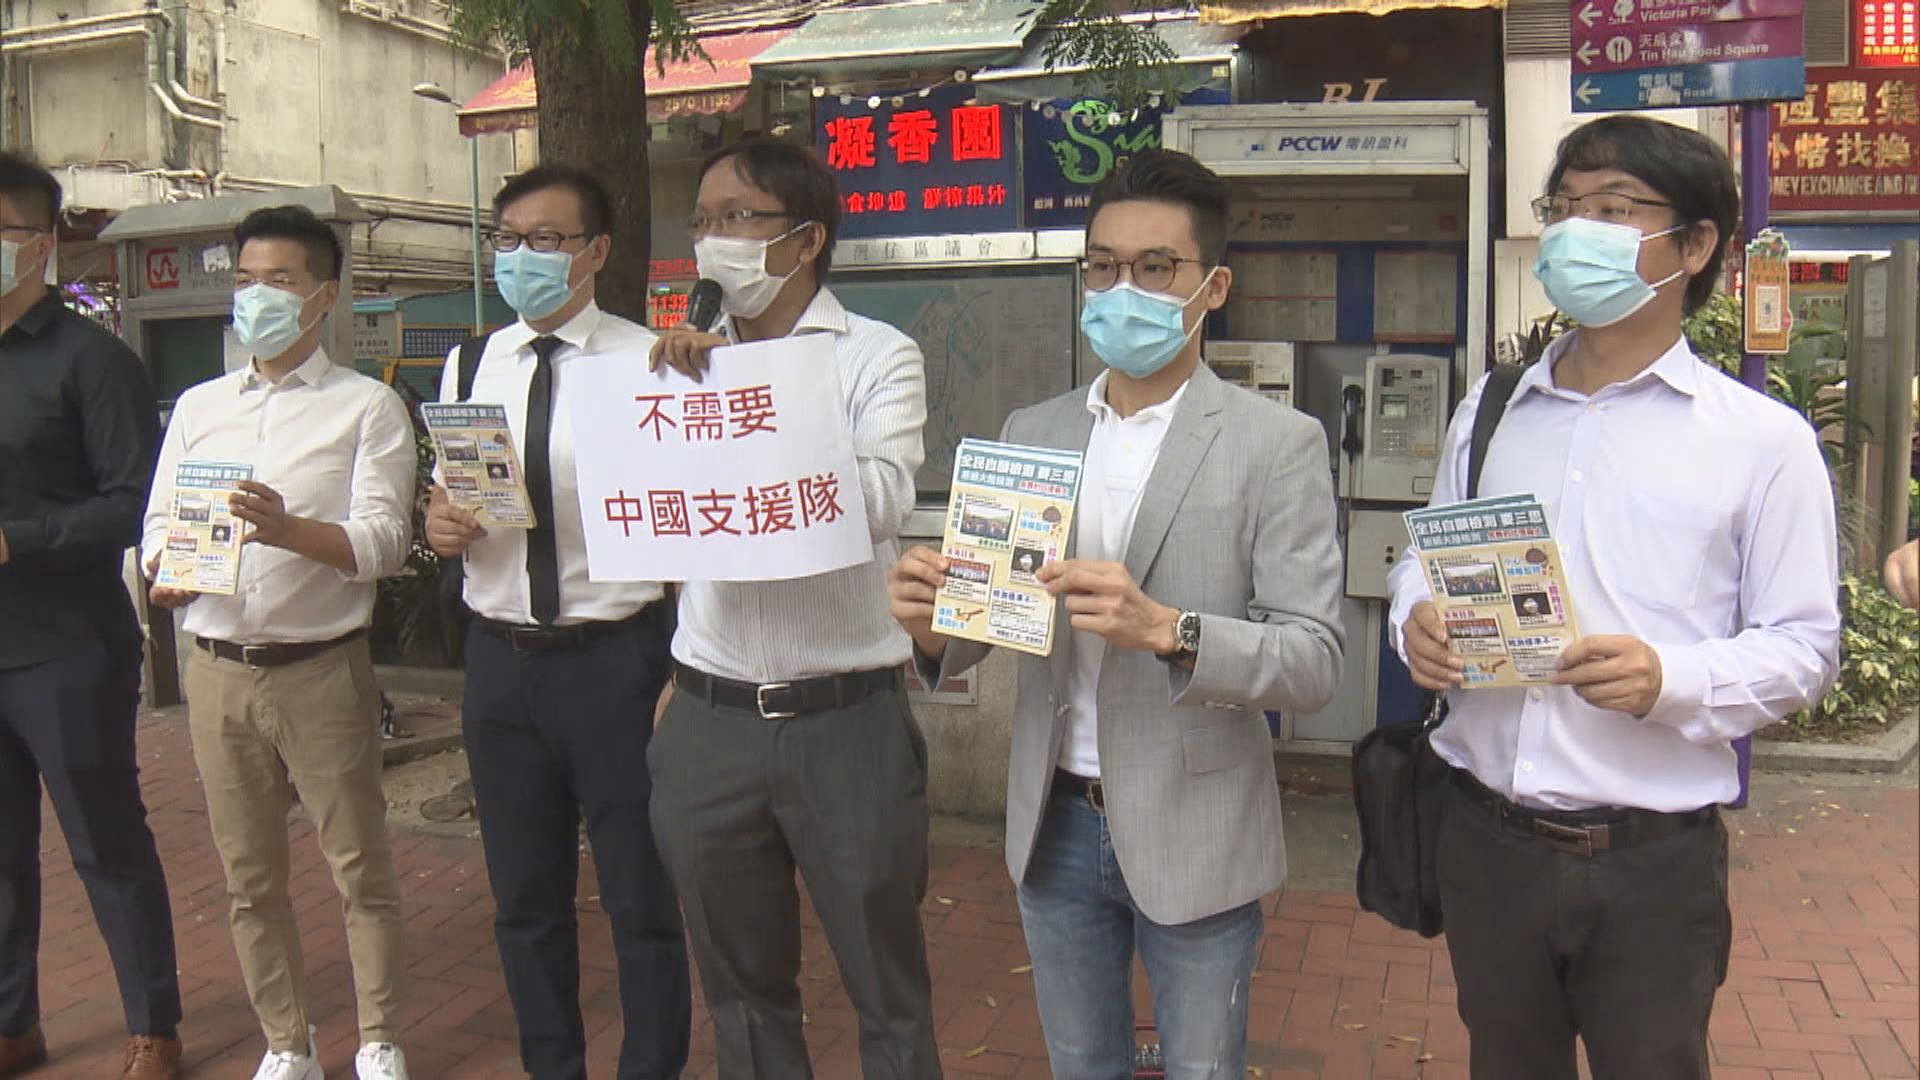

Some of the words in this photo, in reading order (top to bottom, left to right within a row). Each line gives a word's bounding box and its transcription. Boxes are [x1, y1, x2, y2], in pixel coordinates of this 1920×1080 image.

[1640, 9, 1687, 23] Victoria
[1639, 50, 1658, 62] Tin
[1724, 42, 1769, 57] Square
[1278, 136, 1343, 151] PCCW
[1801, 174, 1873, 196] EXCHANGE
[634, 383, 778, 442] 不需要
[603, 471, 845, 538] 中國支援隊
[1414, 513, 1498, 536] 全民自願檢測
